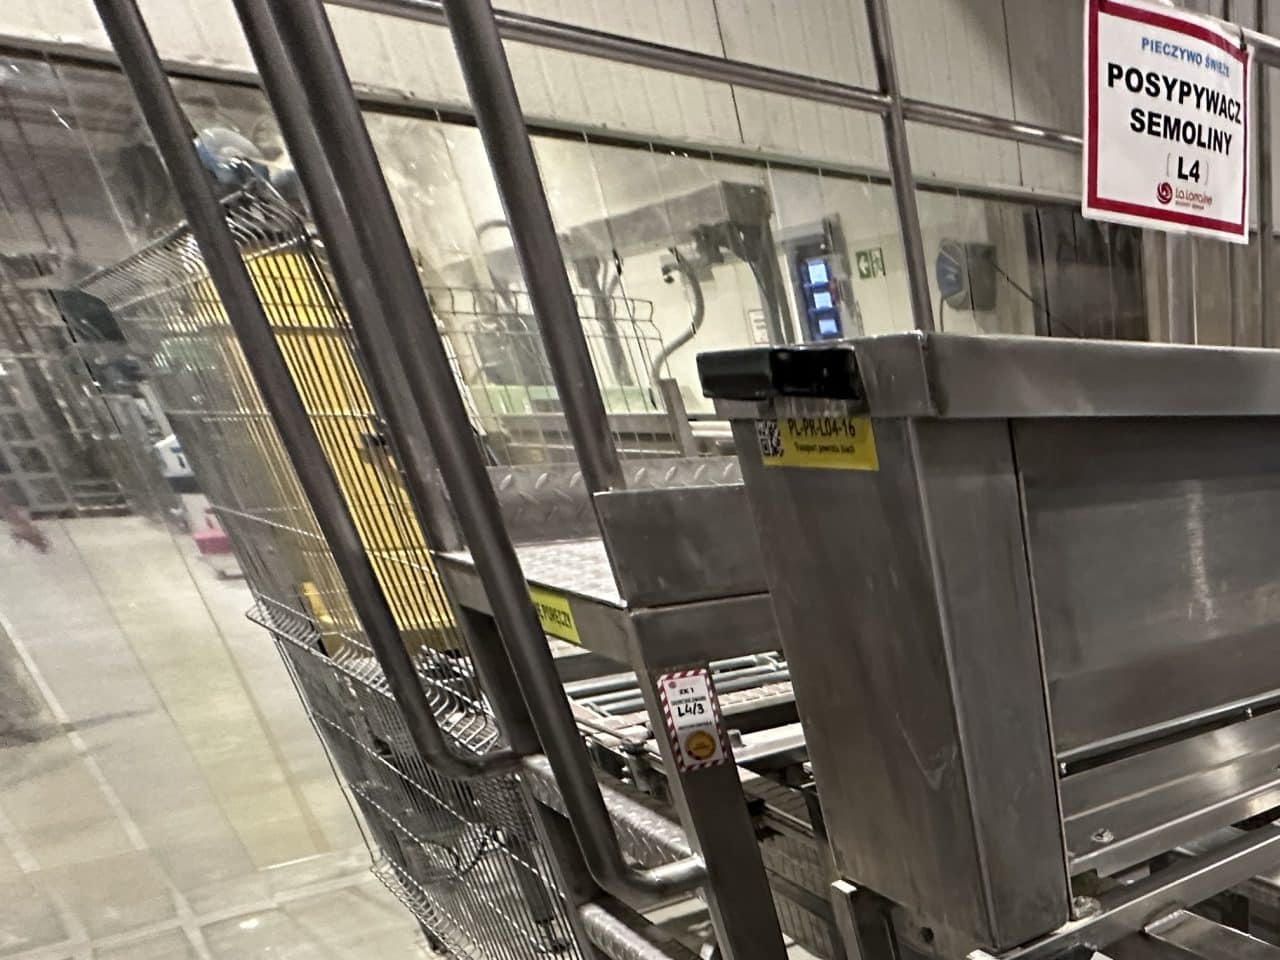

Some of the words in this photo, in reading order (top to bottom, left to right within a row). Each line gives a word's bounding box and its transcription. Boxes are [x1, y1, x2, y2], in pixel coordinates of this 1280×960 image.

[1142, 37, 1202, 66] PIECZYWO
[1108, 62, 1242, 125] POSYPYWACZ
[1130, 107, 1232, 156] SEMOLINY
[1177, 156, 1200, 184] L4
[677, 703, 705, 718] L4/3
